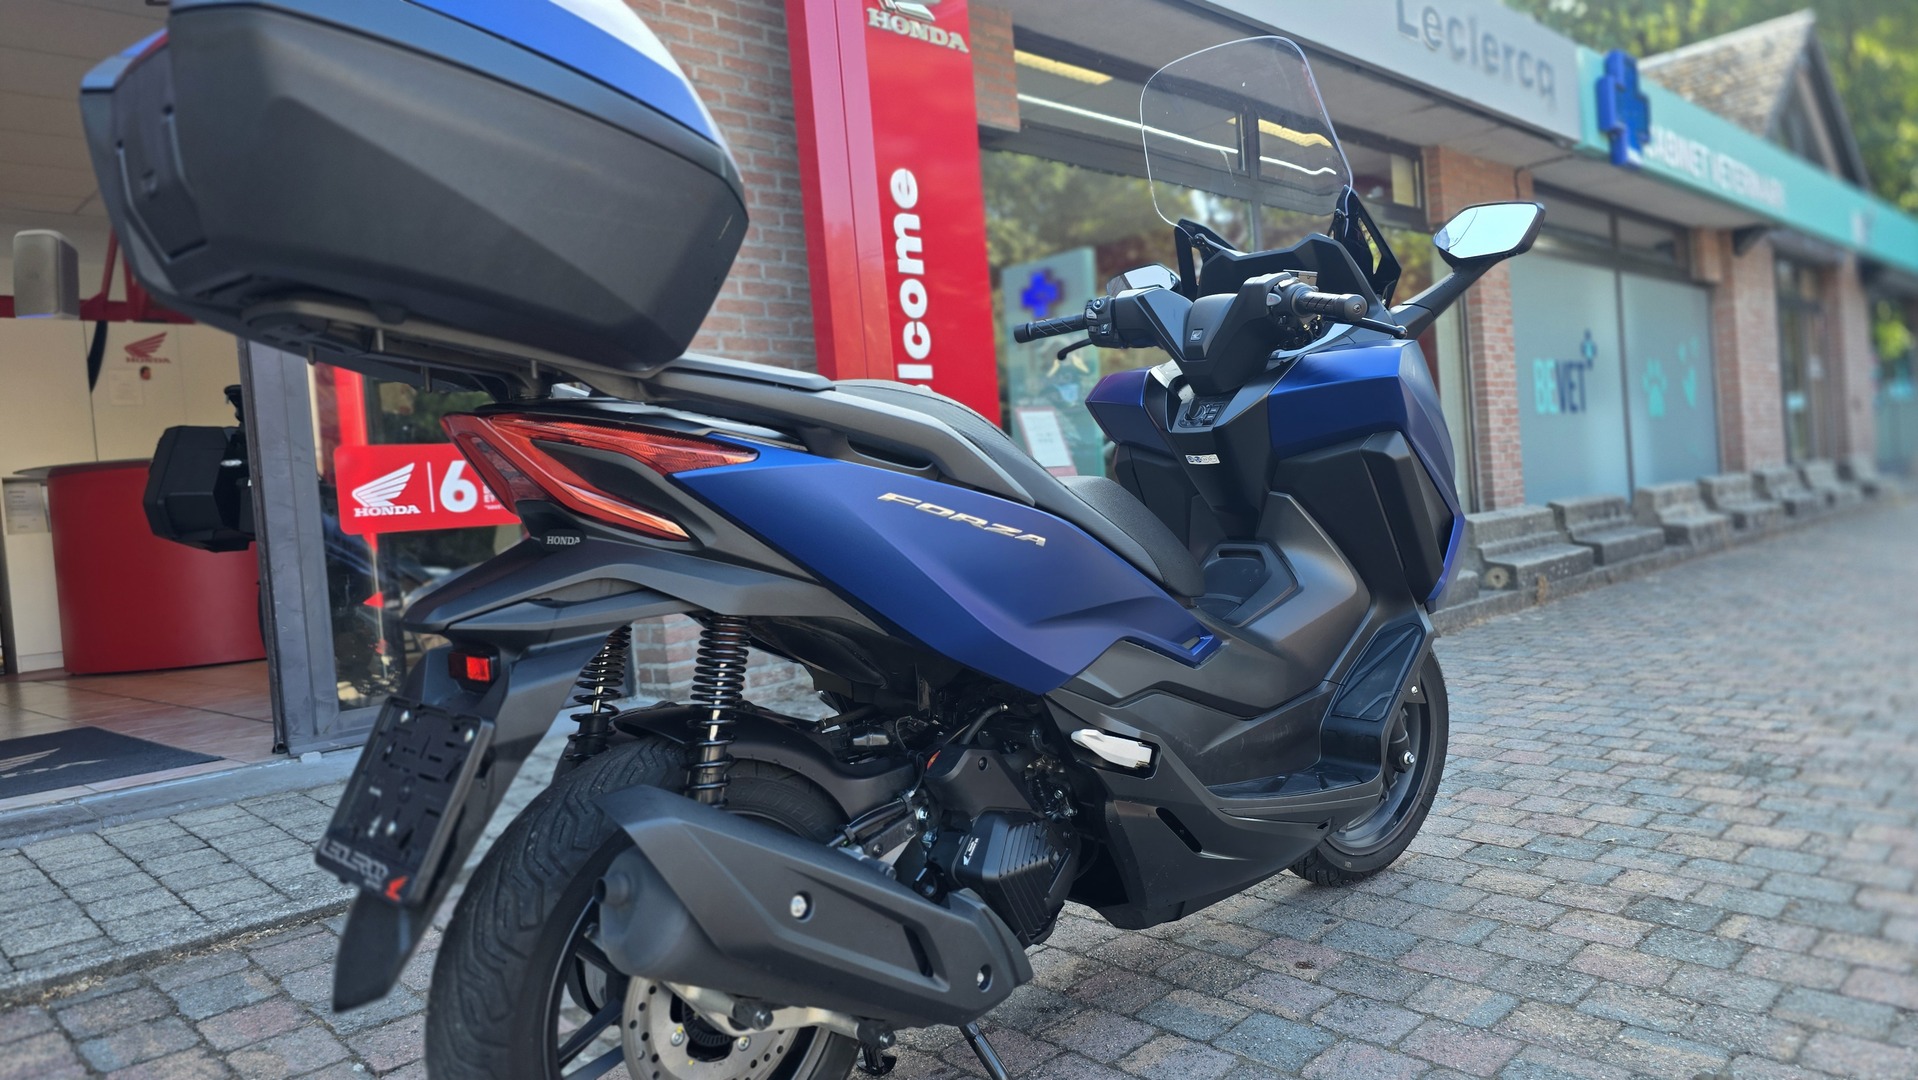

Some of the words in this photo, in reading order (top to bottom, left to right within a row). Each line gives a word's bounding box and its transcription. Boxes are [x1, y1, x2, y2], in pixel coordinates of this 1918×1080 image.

[866, 7, 969, 54] HONDA
[1396, 0, 1556, 114] Leclercq
[1627, 125, 1711, 179] ABINET
[890, 168, 934, 391] lcome
[1533, 357, 1587, 415] BEVET
[354, 504, 421, 518] HONDA
[439, 460, 479, 513] 6
[546, 535, 581, 546] HONDA
[877, 492, 1046, 547] FORZA
